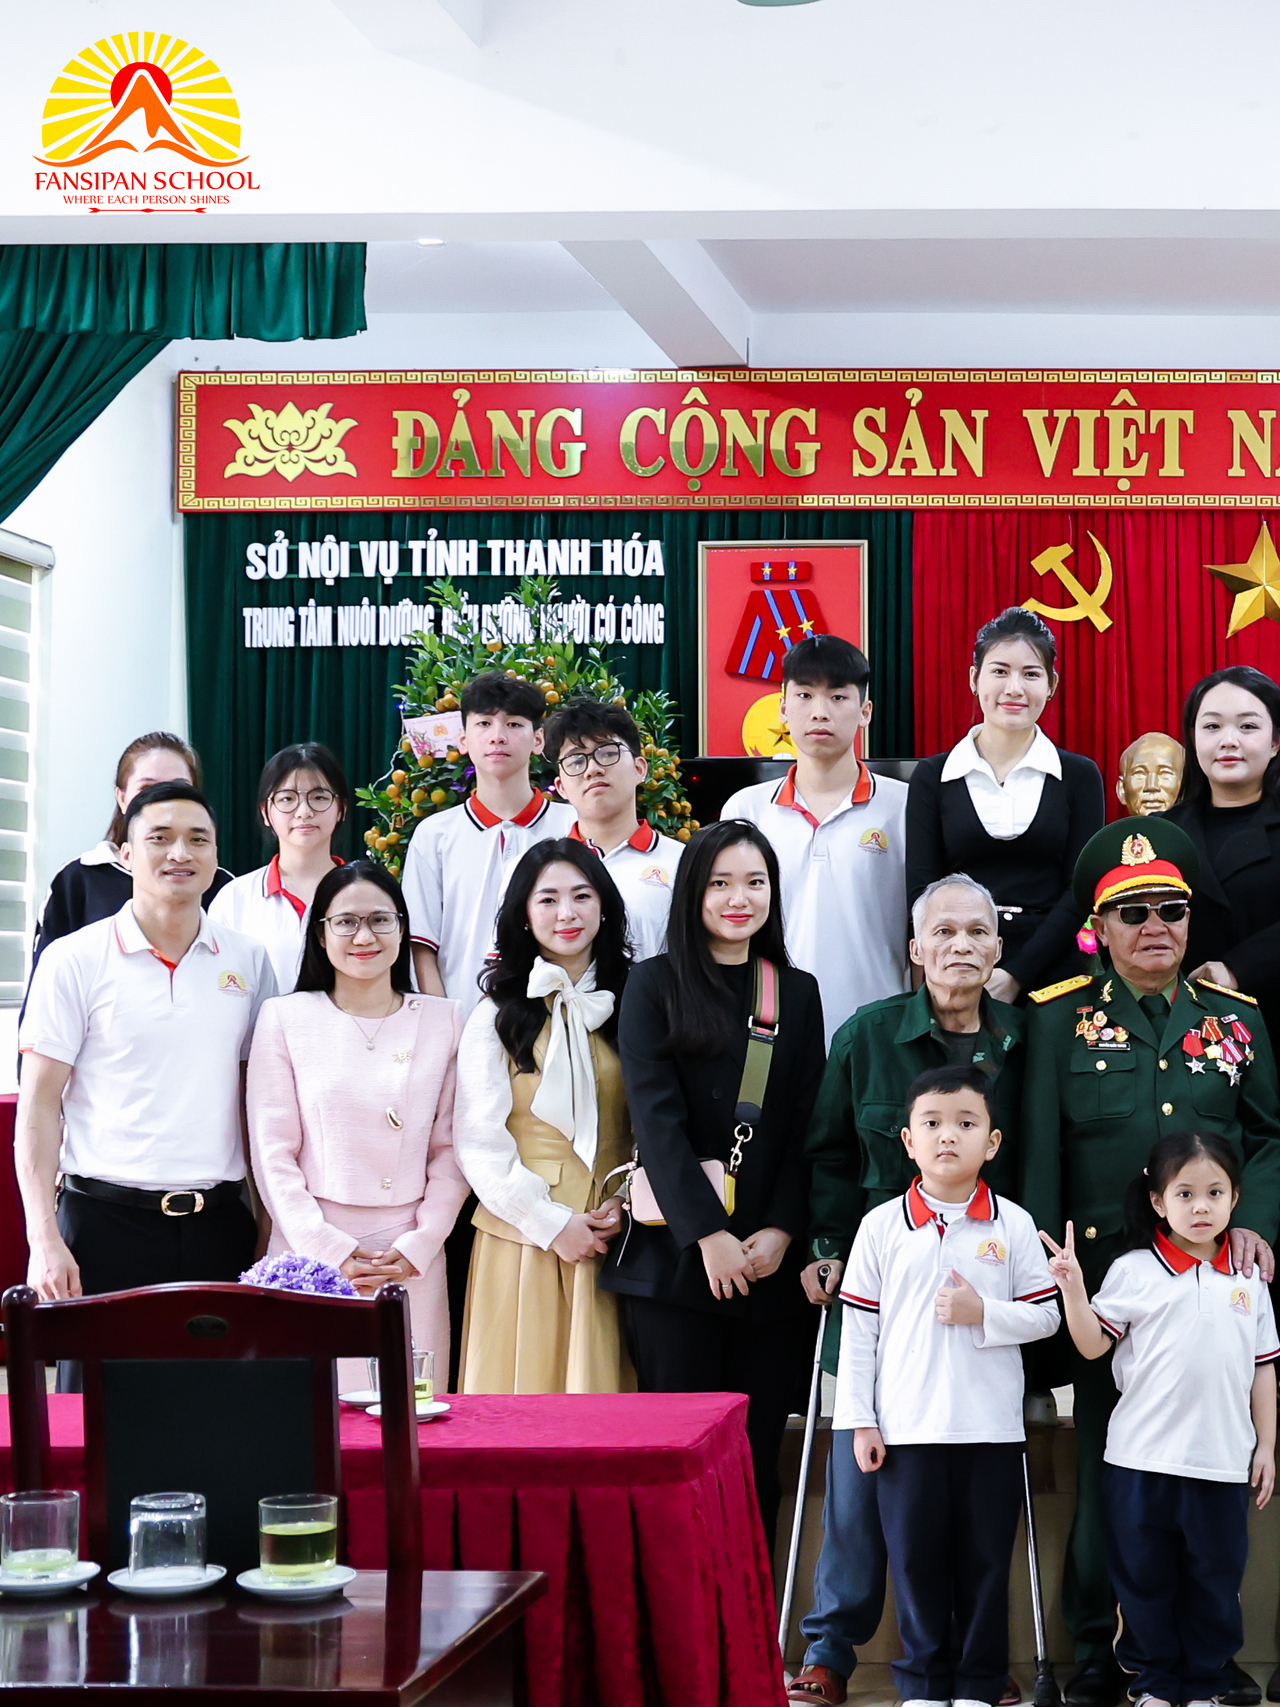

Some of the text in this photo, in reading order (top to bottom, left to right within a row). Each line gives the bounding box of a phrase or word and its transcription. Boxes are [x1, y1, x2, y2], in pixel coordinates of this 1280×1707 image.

[391, 388, 587, 478] ĐẢNG
[619, 387, 821, 491] CỘNG
[851, 388, 989, 478] SẢN
[1022, 388, 1194, 491] VIỆT
[245, 527, 665, 586] SỞ NỘI VỤ TỈNH THANH HÓA
[242, 606, 295, 648] TRUNG
[298, 598, 333, 647] TÂM
[337, 596, 376, 646] NUÔI
[594, 594, 617, 645] CÓ
[620, 594, 665, 645] CÔNG
